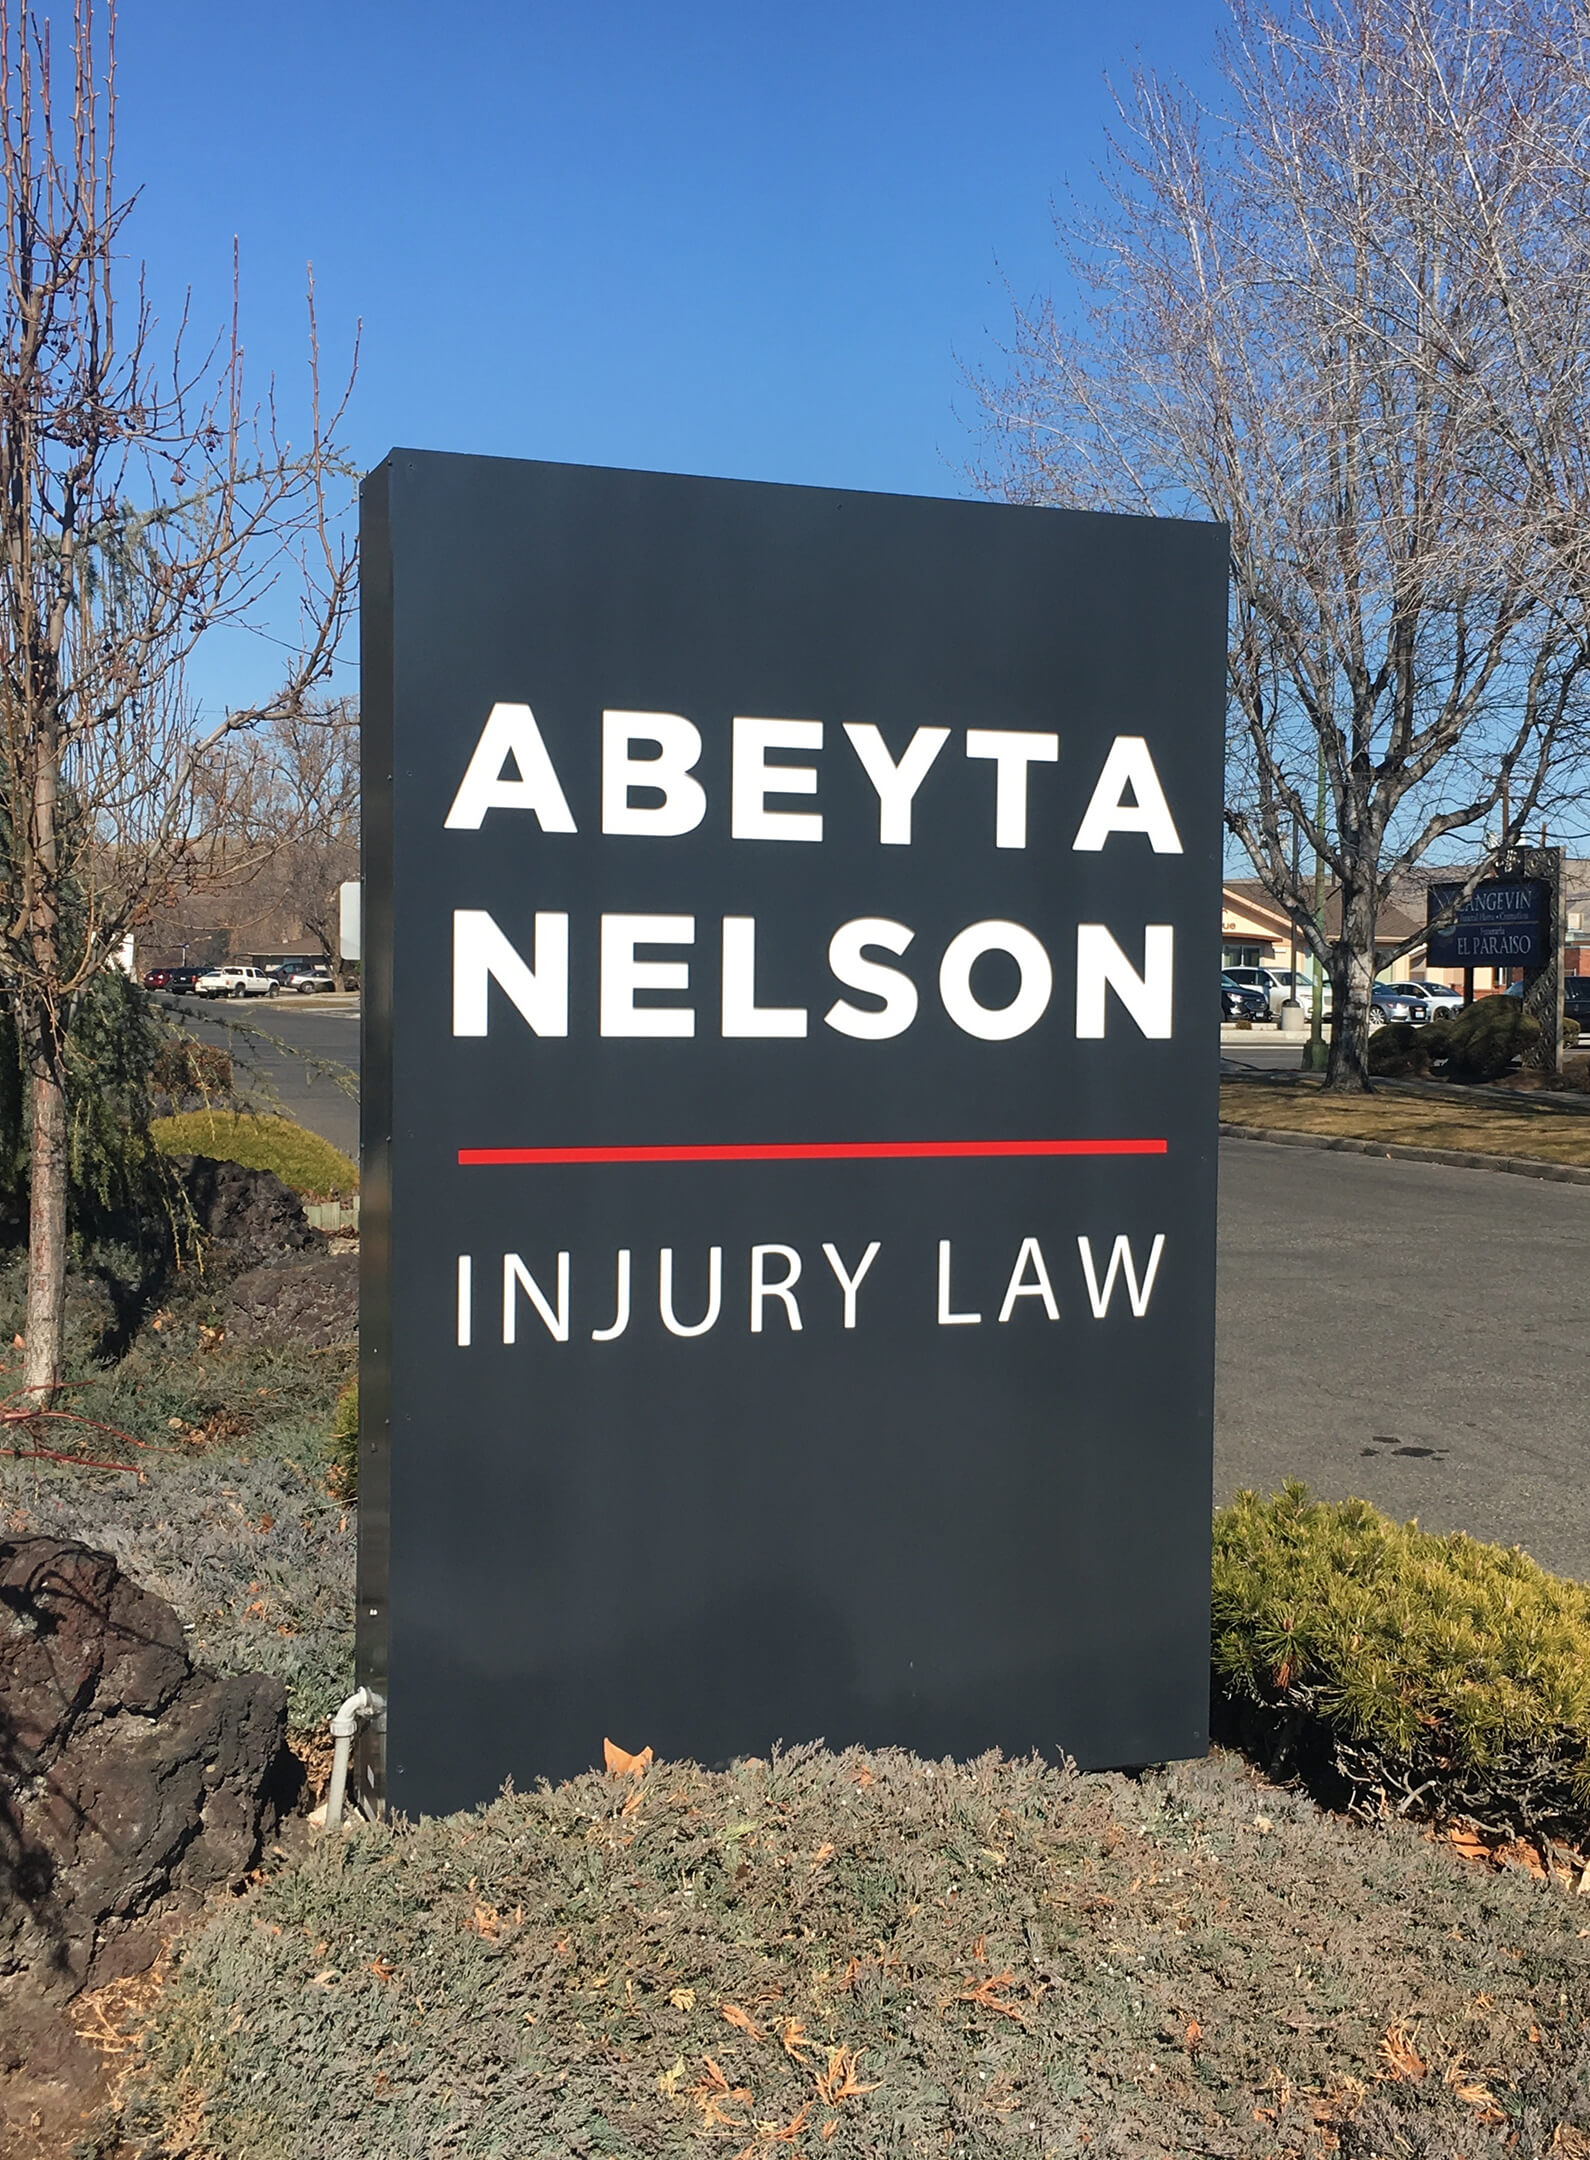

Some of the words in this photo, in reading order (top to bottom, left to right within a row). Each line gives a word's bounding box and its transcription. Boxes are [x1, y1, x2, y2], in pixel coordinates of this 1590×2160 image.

[443, 702, 1184, 854] ABEYTA
[453, 909, 1174, 1041] NELSON
[1457, 938, 1470, 956] EL
[1473, 935, 1532, 955] PARAISO
[457, 1241, 881, 1347] INJURY
[938, 1233, 1165, 1325] LAW
